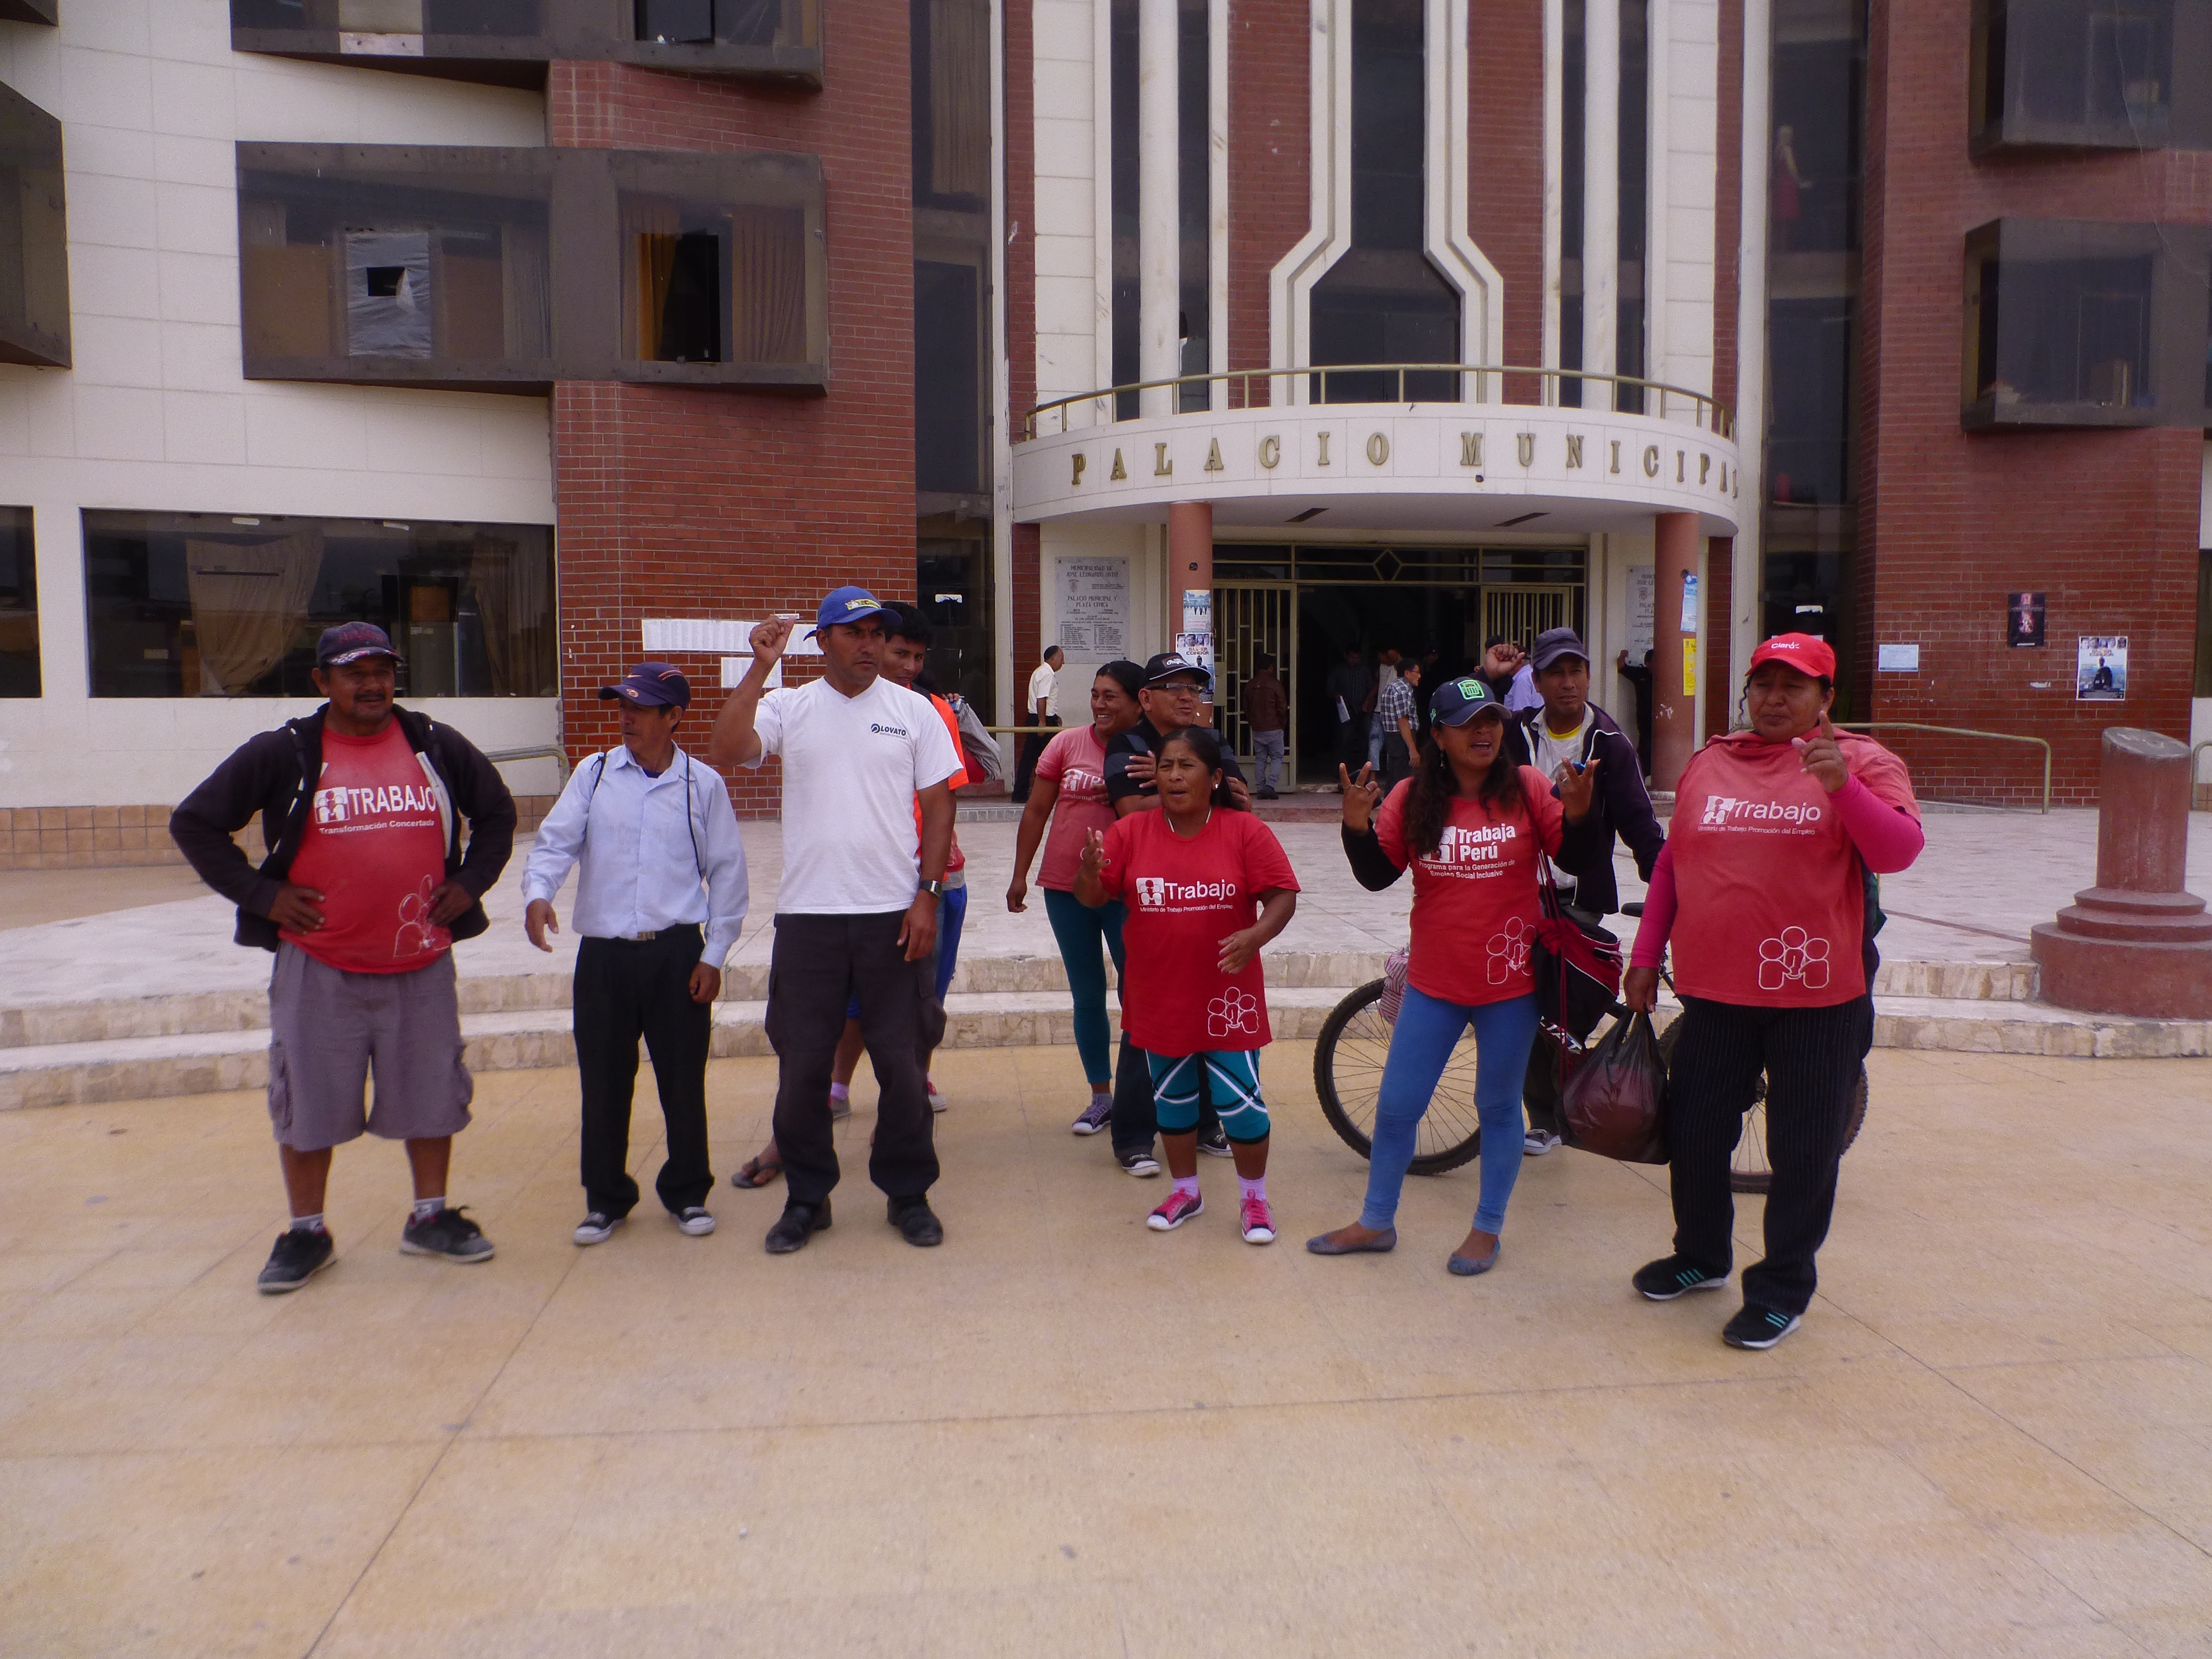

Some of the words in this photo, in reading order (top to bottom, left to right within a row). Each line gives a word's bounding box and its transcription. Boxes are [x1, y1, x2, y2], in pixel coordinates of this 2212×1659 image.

[1071, 431, 1389, 485] PALACIO
[1460, 432, 1738, 499] MUNICIPAL
[881, 726, 906, 736] LOVATO
[348, 785, 436, 815] TRABAJO
[1734, 801, 1821, 825] Trabajo
[319, 822, 387, 834] Transformación
[1457, 823, 1516, 844] Trabaja
[1460, 842, 1498, 861] Perú
[1419, 861, 1446, 870] Programa
[1472, 860, 1507, 869] Generación
[1477, 870, 1503, 879] Inclusivo
[1164, 879, 1236, 901] Trabajo
